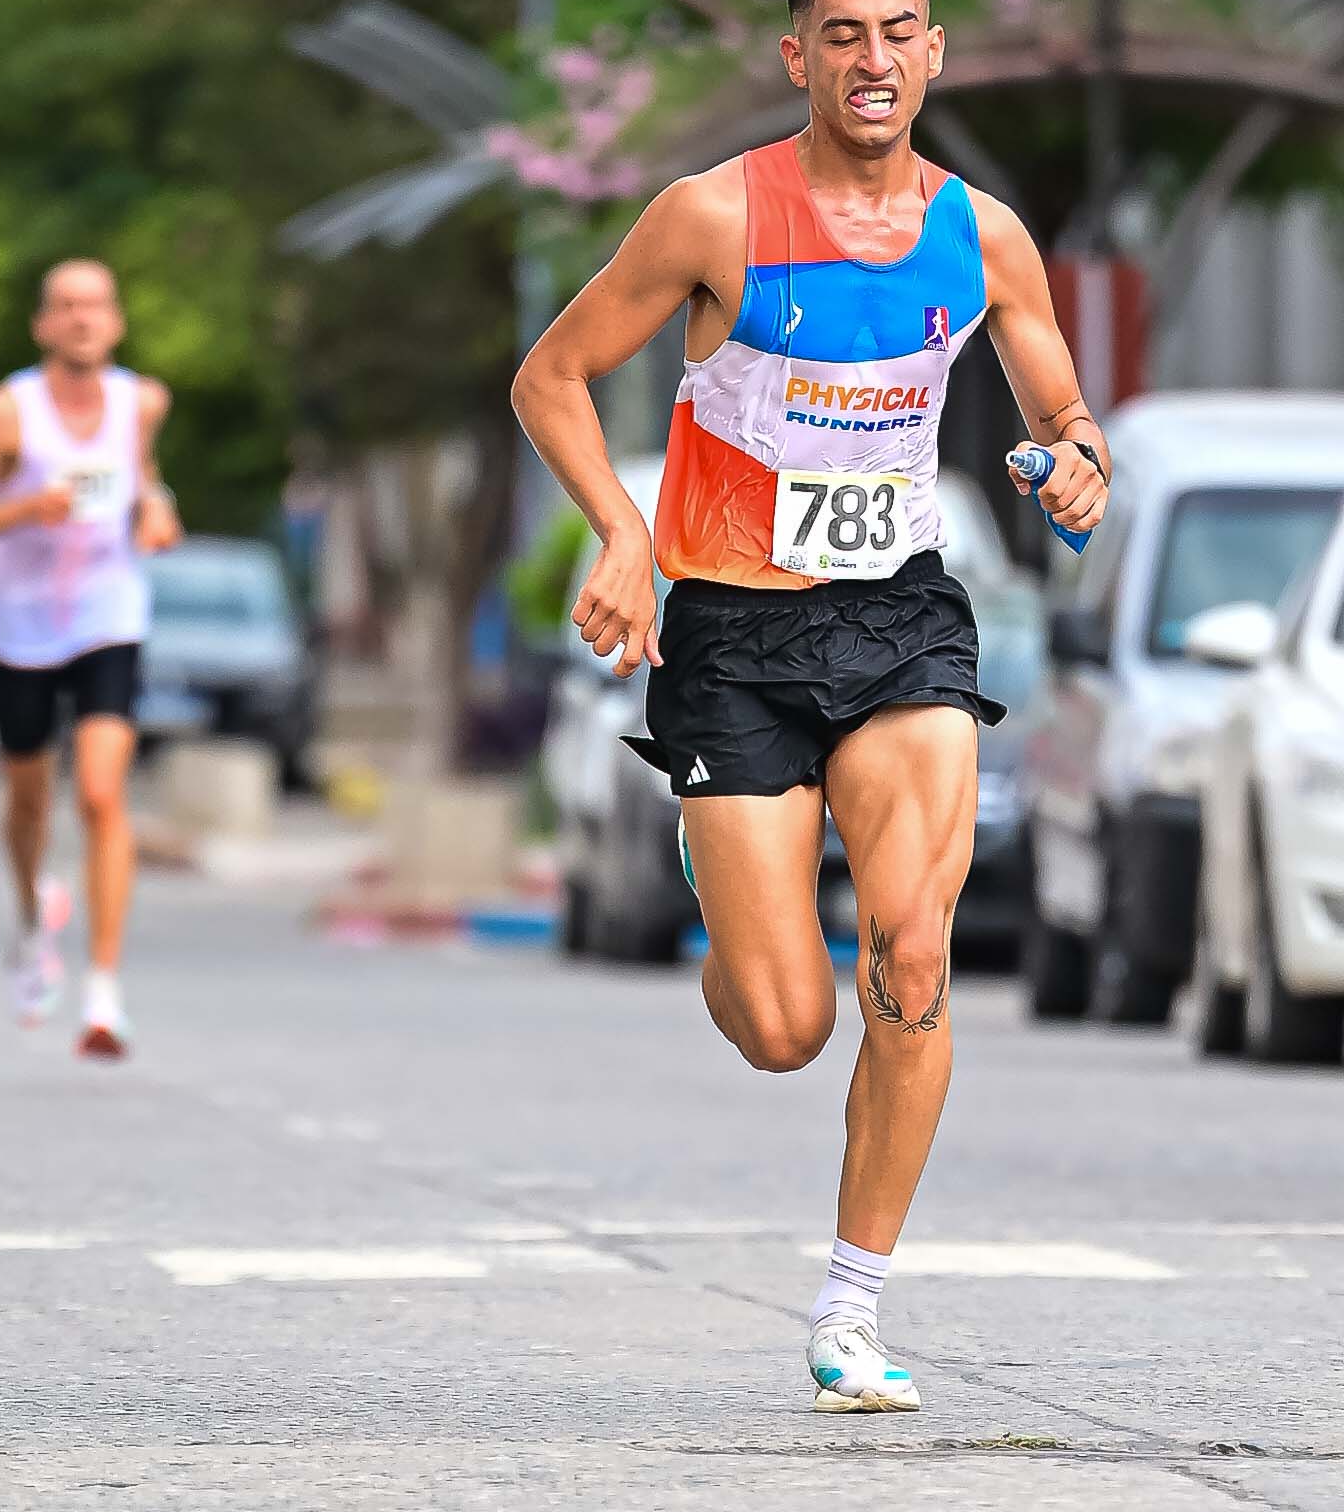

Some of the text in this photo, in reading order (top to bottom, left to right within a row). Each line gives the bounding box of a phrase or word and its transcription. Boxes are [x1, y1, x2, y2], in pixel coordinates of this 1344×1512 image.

[785, 377, 930, 412] PHYSICAL
[785, 410, 924, 433] RUNNERS
[790, 481, 896, 551] 783
